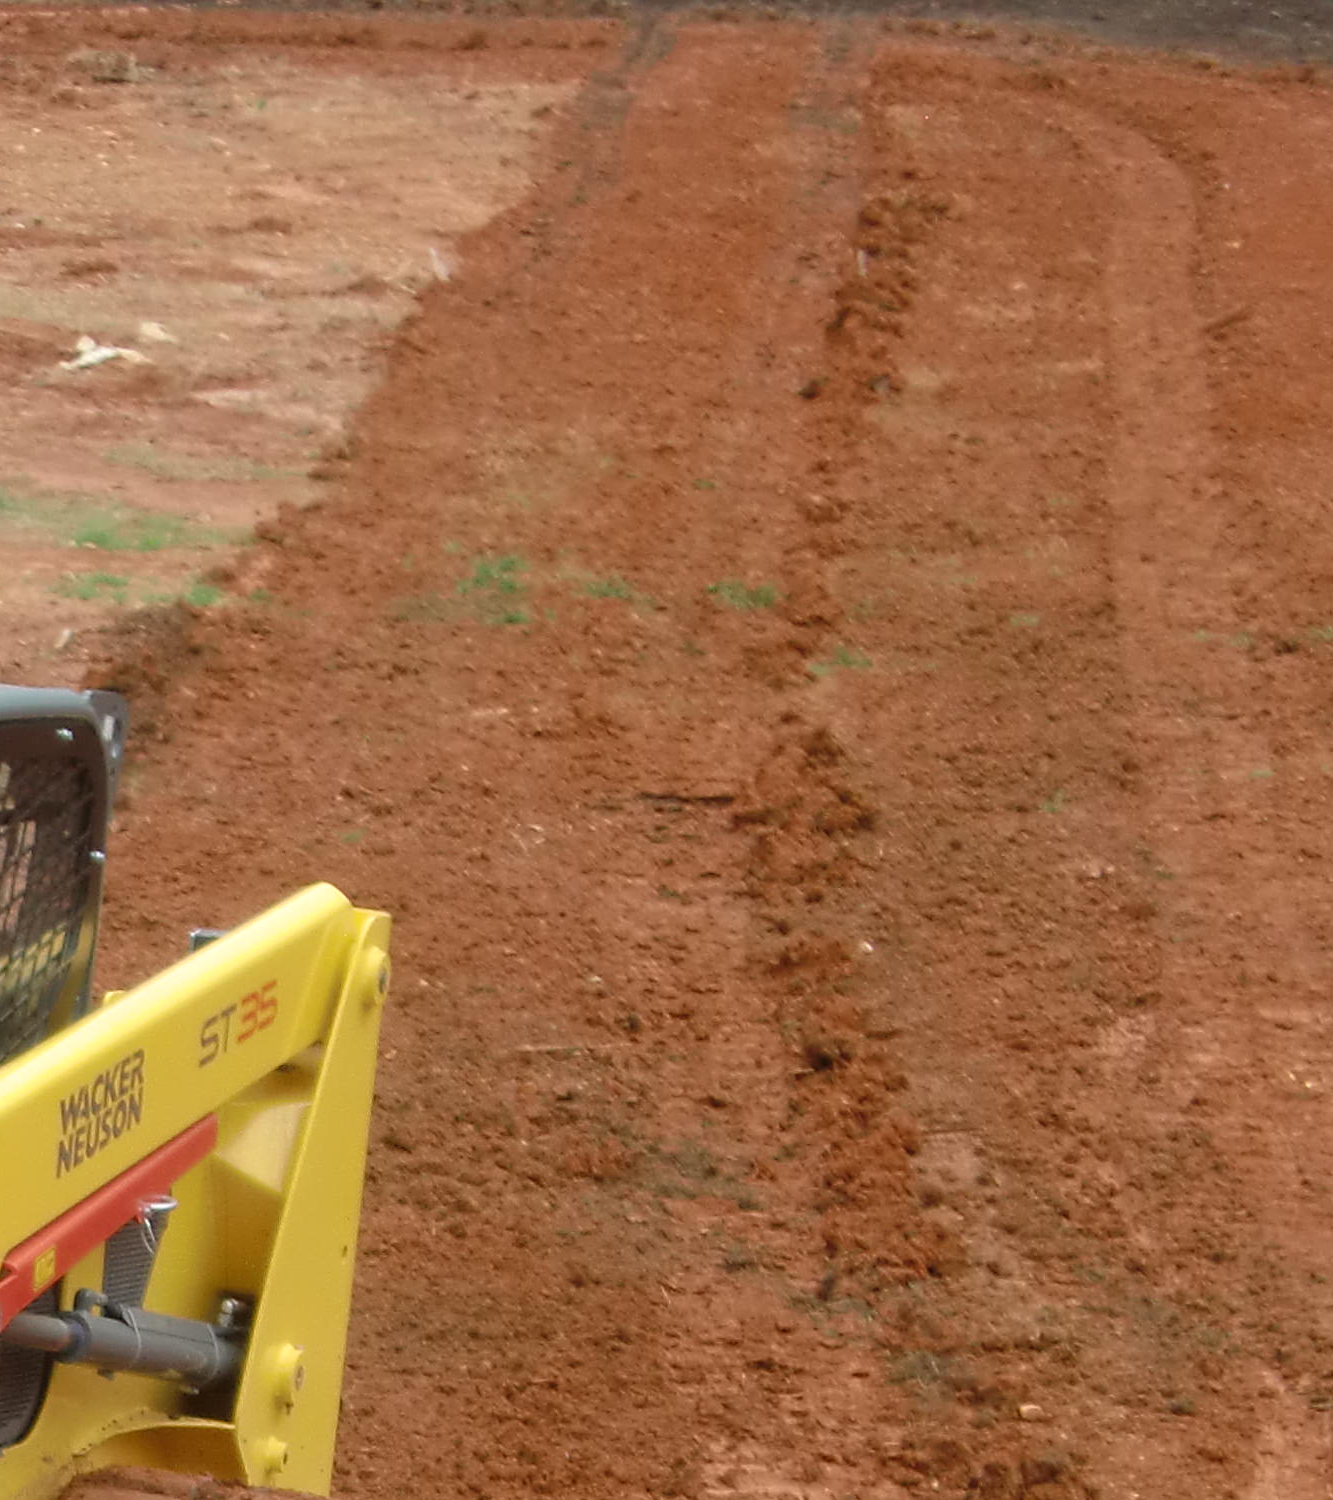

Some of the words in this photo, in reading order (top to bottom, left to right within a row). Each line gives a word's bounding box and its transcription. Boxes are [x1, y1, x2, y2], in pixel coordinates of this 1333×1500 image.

[199, 979, 277, 1067] ST35
[56, 1086, 143, 1178] NEUSON
[60, 1048, 144, 1134] WACKER
